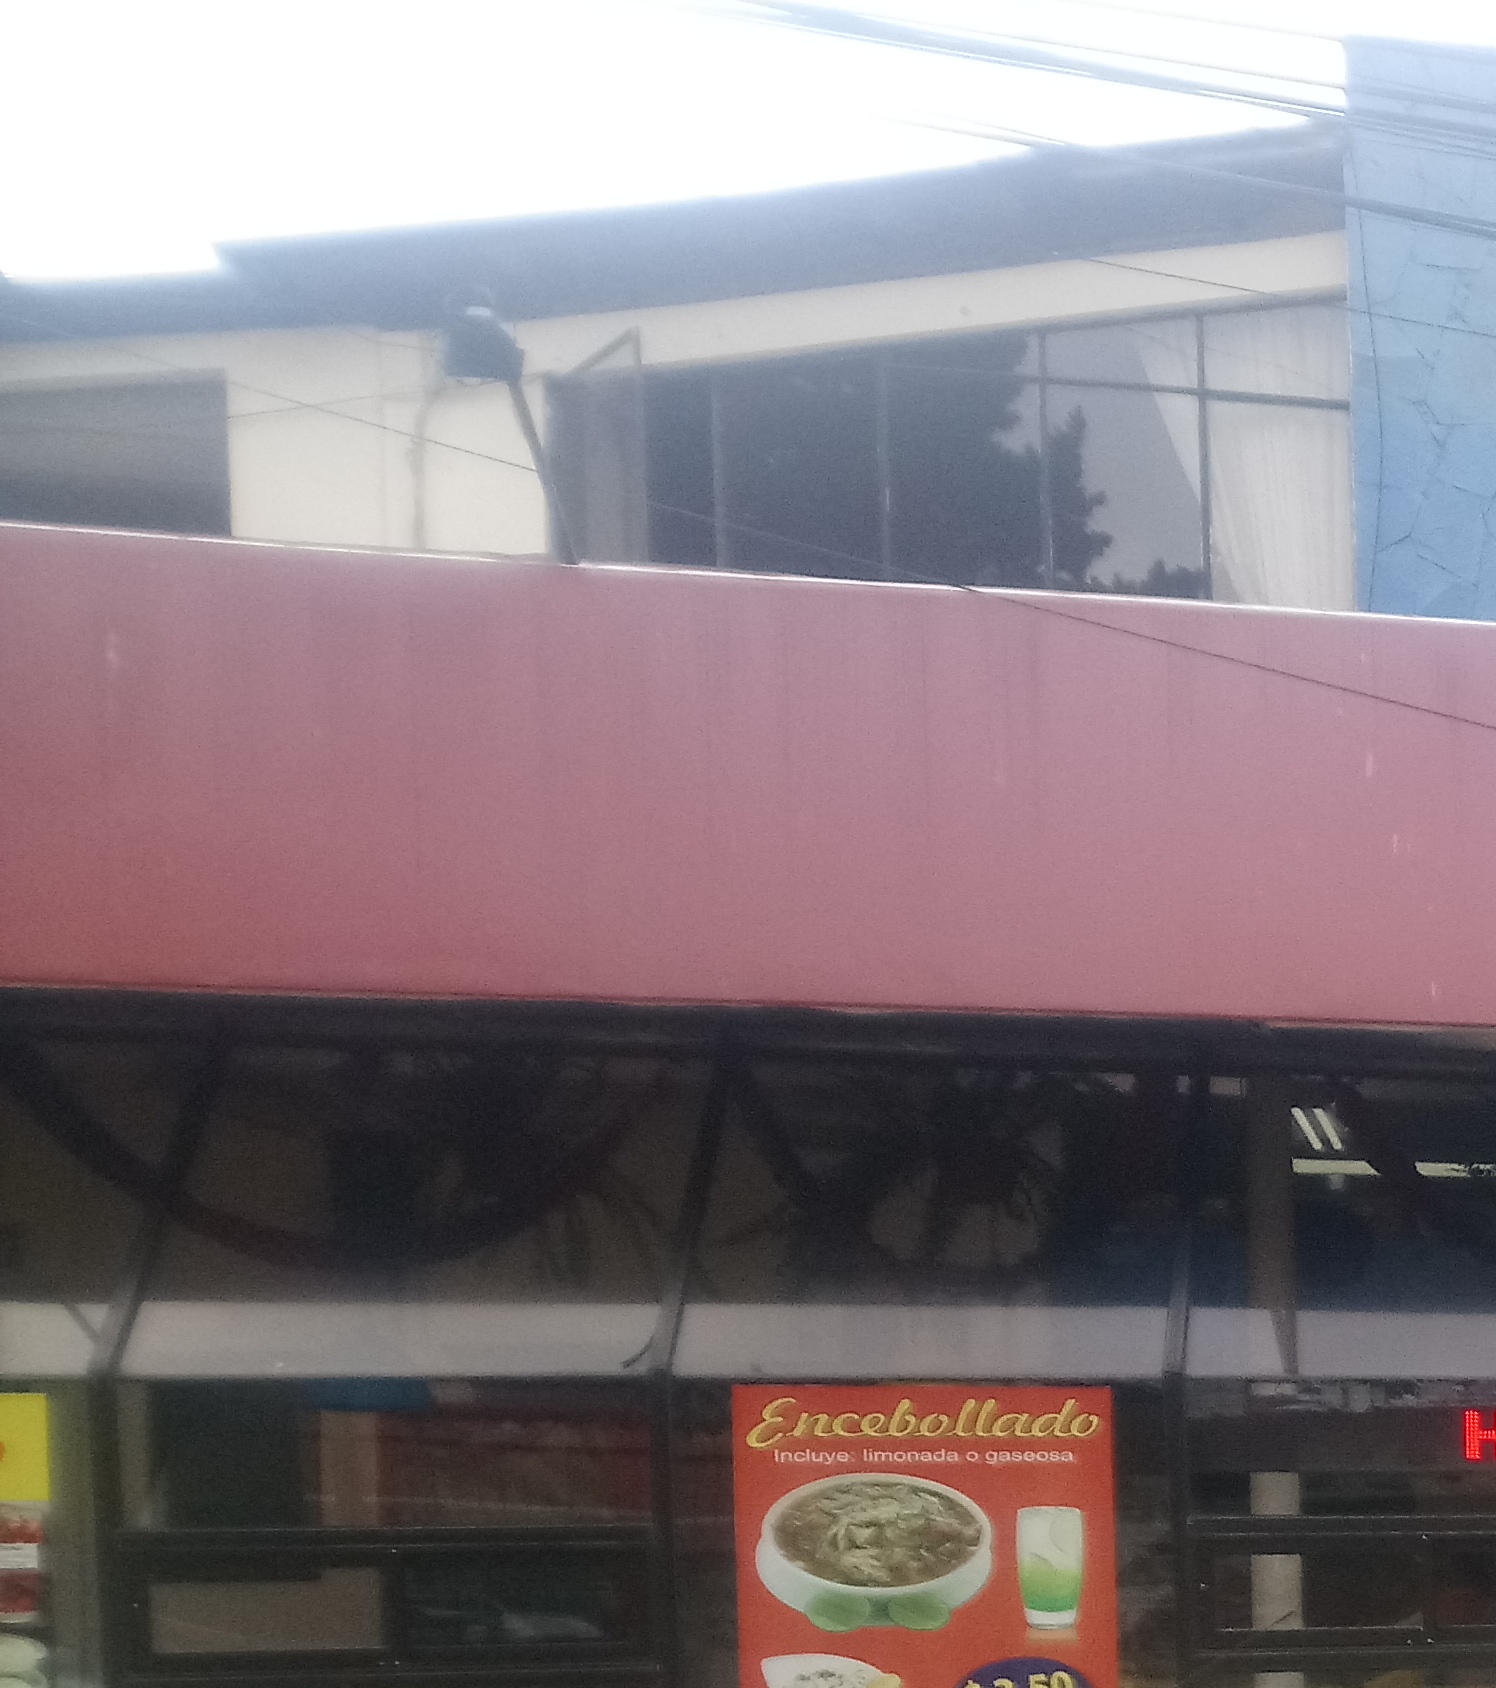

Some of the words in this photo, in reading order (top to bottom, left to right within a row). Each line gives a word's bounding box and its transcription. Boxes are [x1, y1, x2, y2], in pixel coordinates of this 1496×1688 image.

[747, 1396, 1102, 1448] Encebollado
[774, 1449, 855, 1466] Incluye:
[862, 1448, 958, 1464] limonada
[965, 1452, 979, 1463] o
[984, 1450, 1074, 1466] gaseosa
